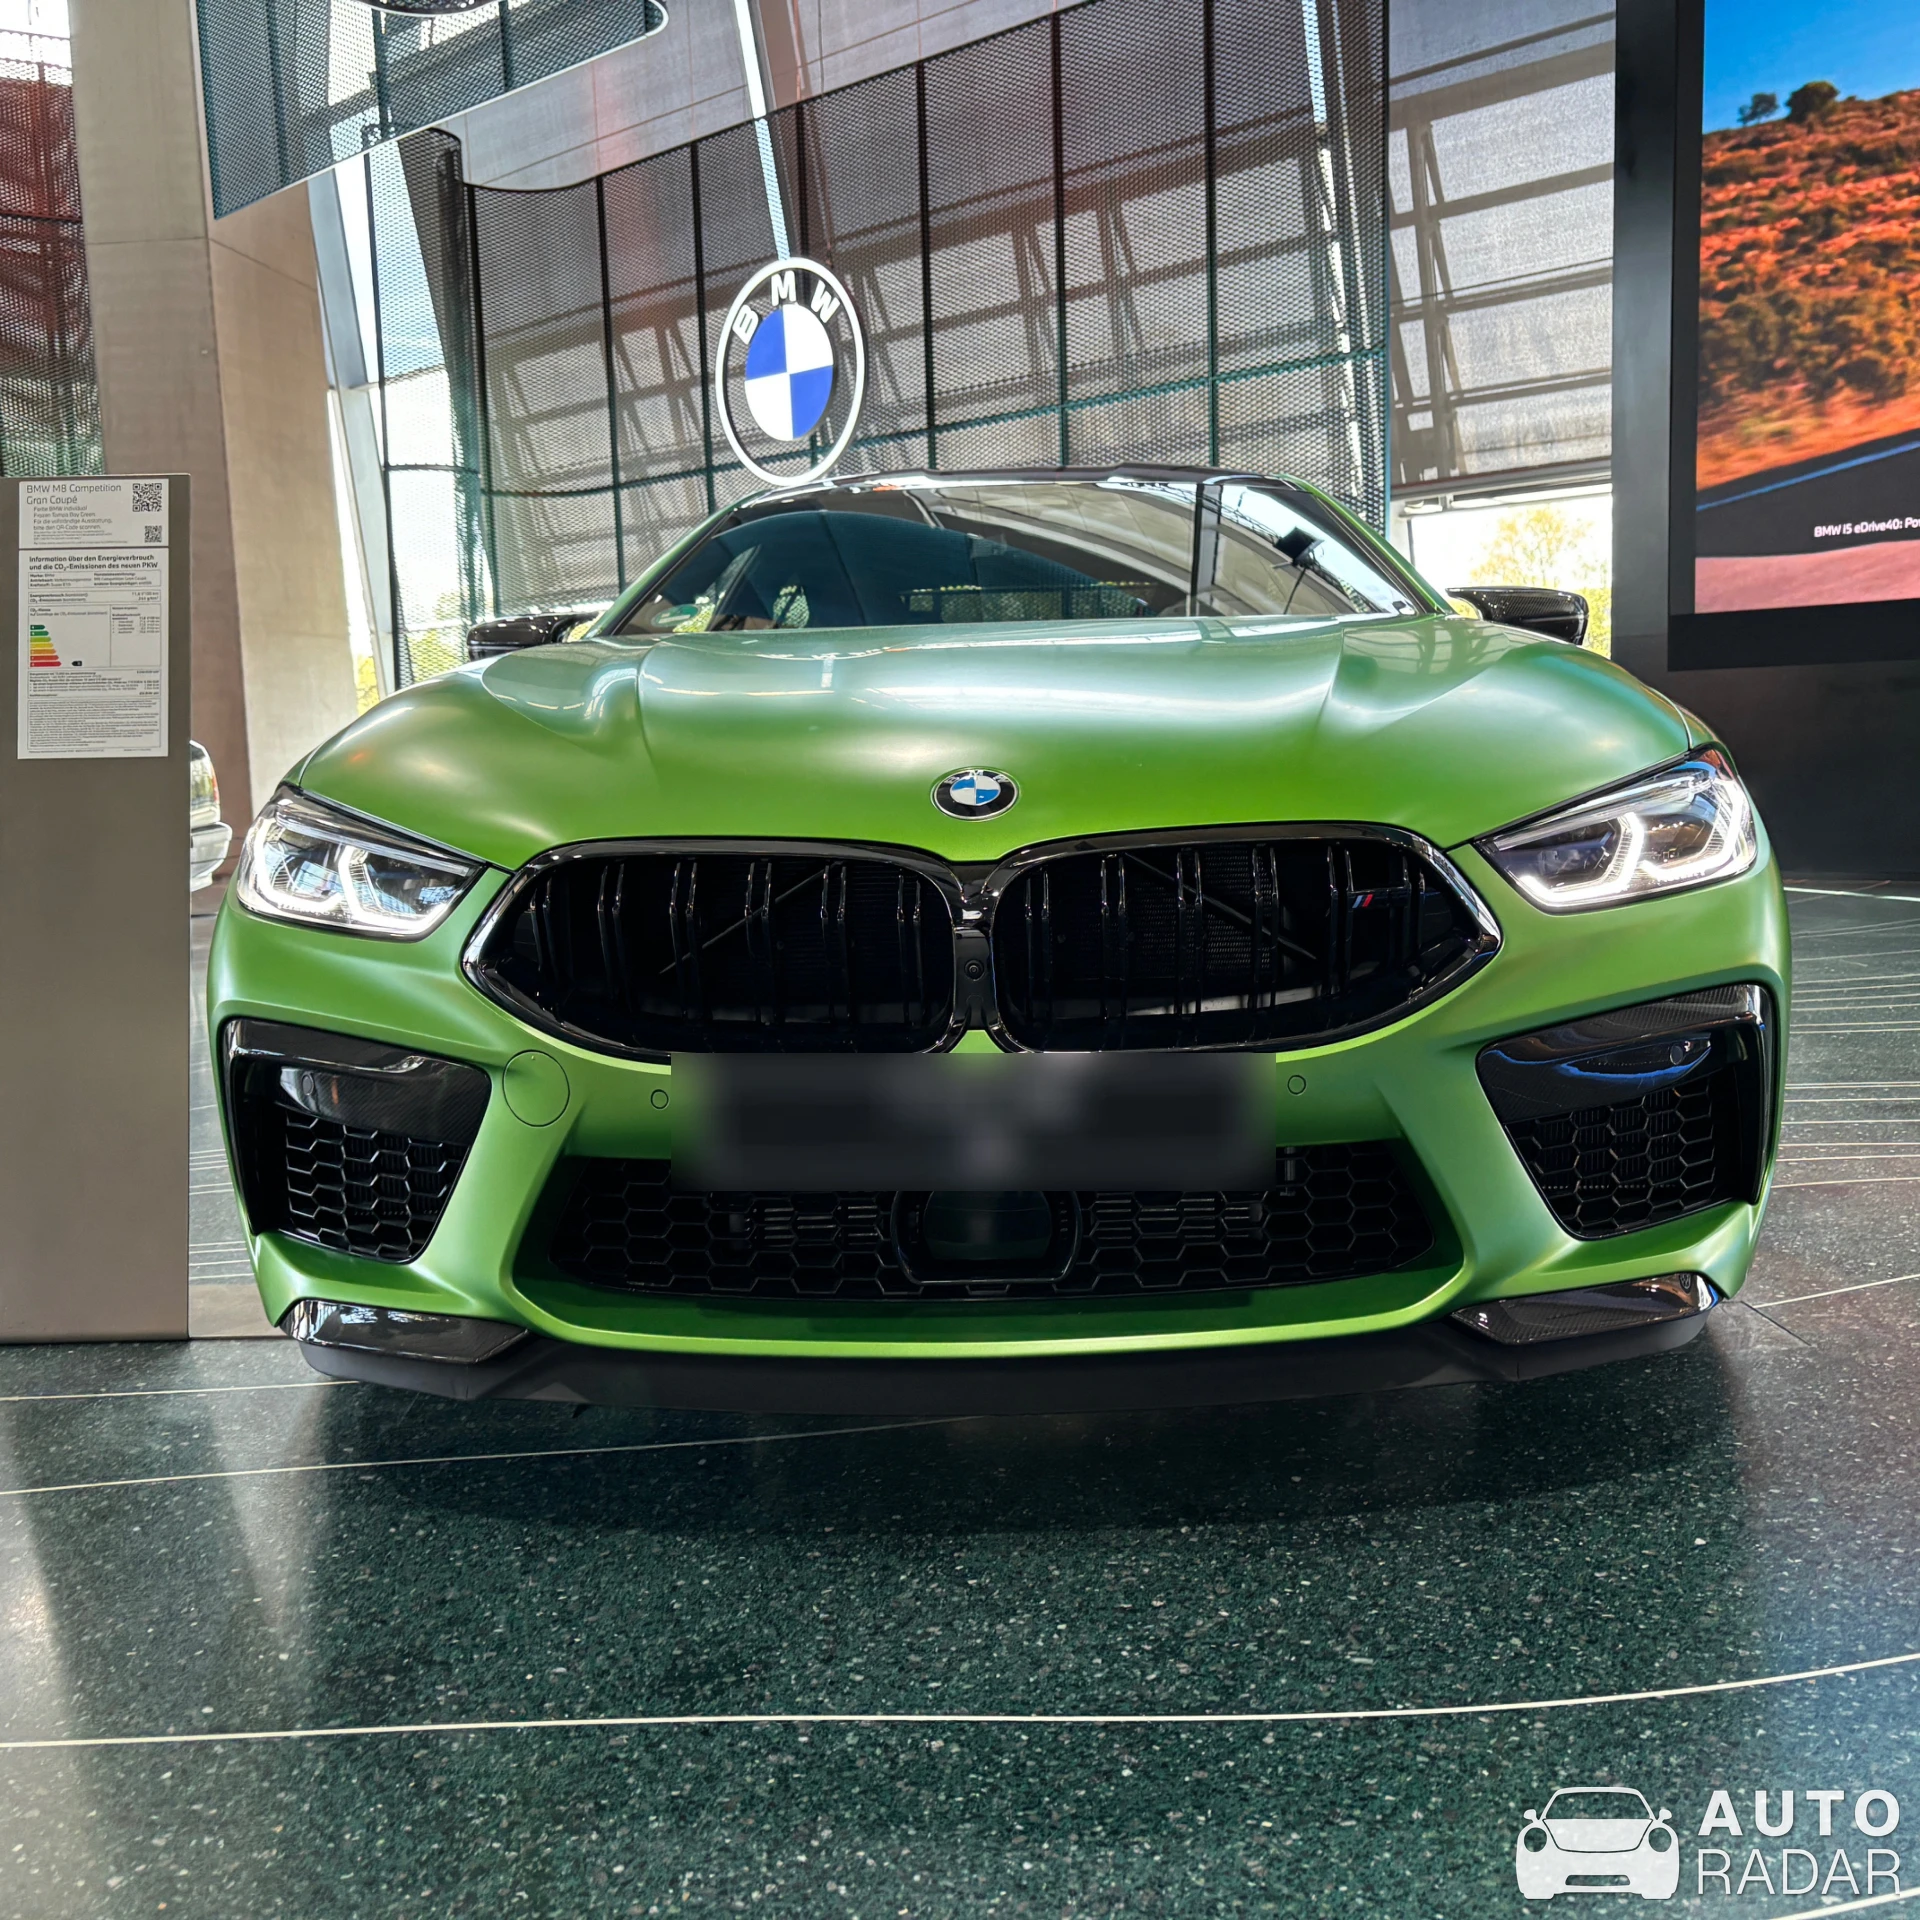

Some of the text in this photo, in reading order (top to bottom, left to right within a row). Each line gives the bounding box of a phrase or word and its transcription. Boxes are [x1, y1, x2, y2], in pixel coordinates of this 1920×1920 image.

[732, 270, 841, 345] BMW
[26, 483, 122, 494] BMW M8 Competition
[26, 495, 78, 505] Gran Coupé
[1814, 524, 1841, 537] BMW
[1854, 518, 1903, 533] eDrive40:
[97, 554, 155, 563] Energieverbrauch
